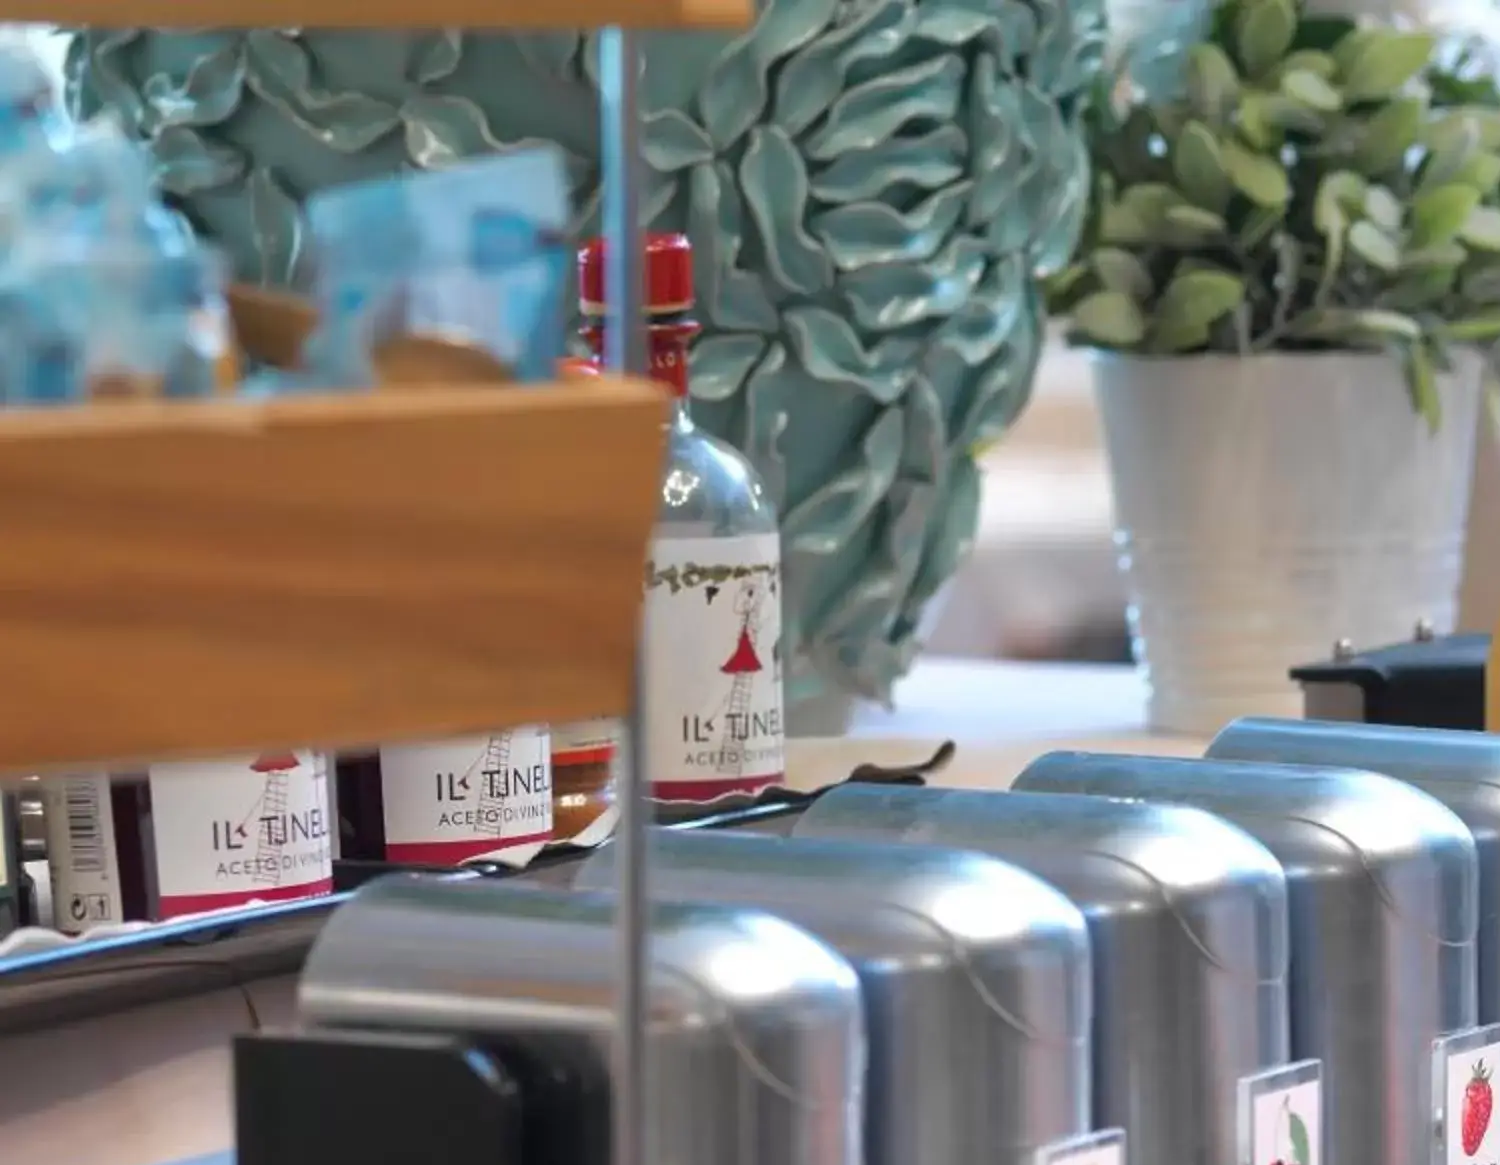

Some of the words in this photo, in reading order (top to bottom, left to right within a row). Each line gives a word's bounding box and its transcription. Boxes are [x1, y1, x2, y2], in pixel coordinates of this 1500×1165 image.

[435, 773, 466, 801] IL
[438, 809, 499, 826] ACETO
[212, 820, 243, 850] IL
[216, 857, 278, 876] ACETO
